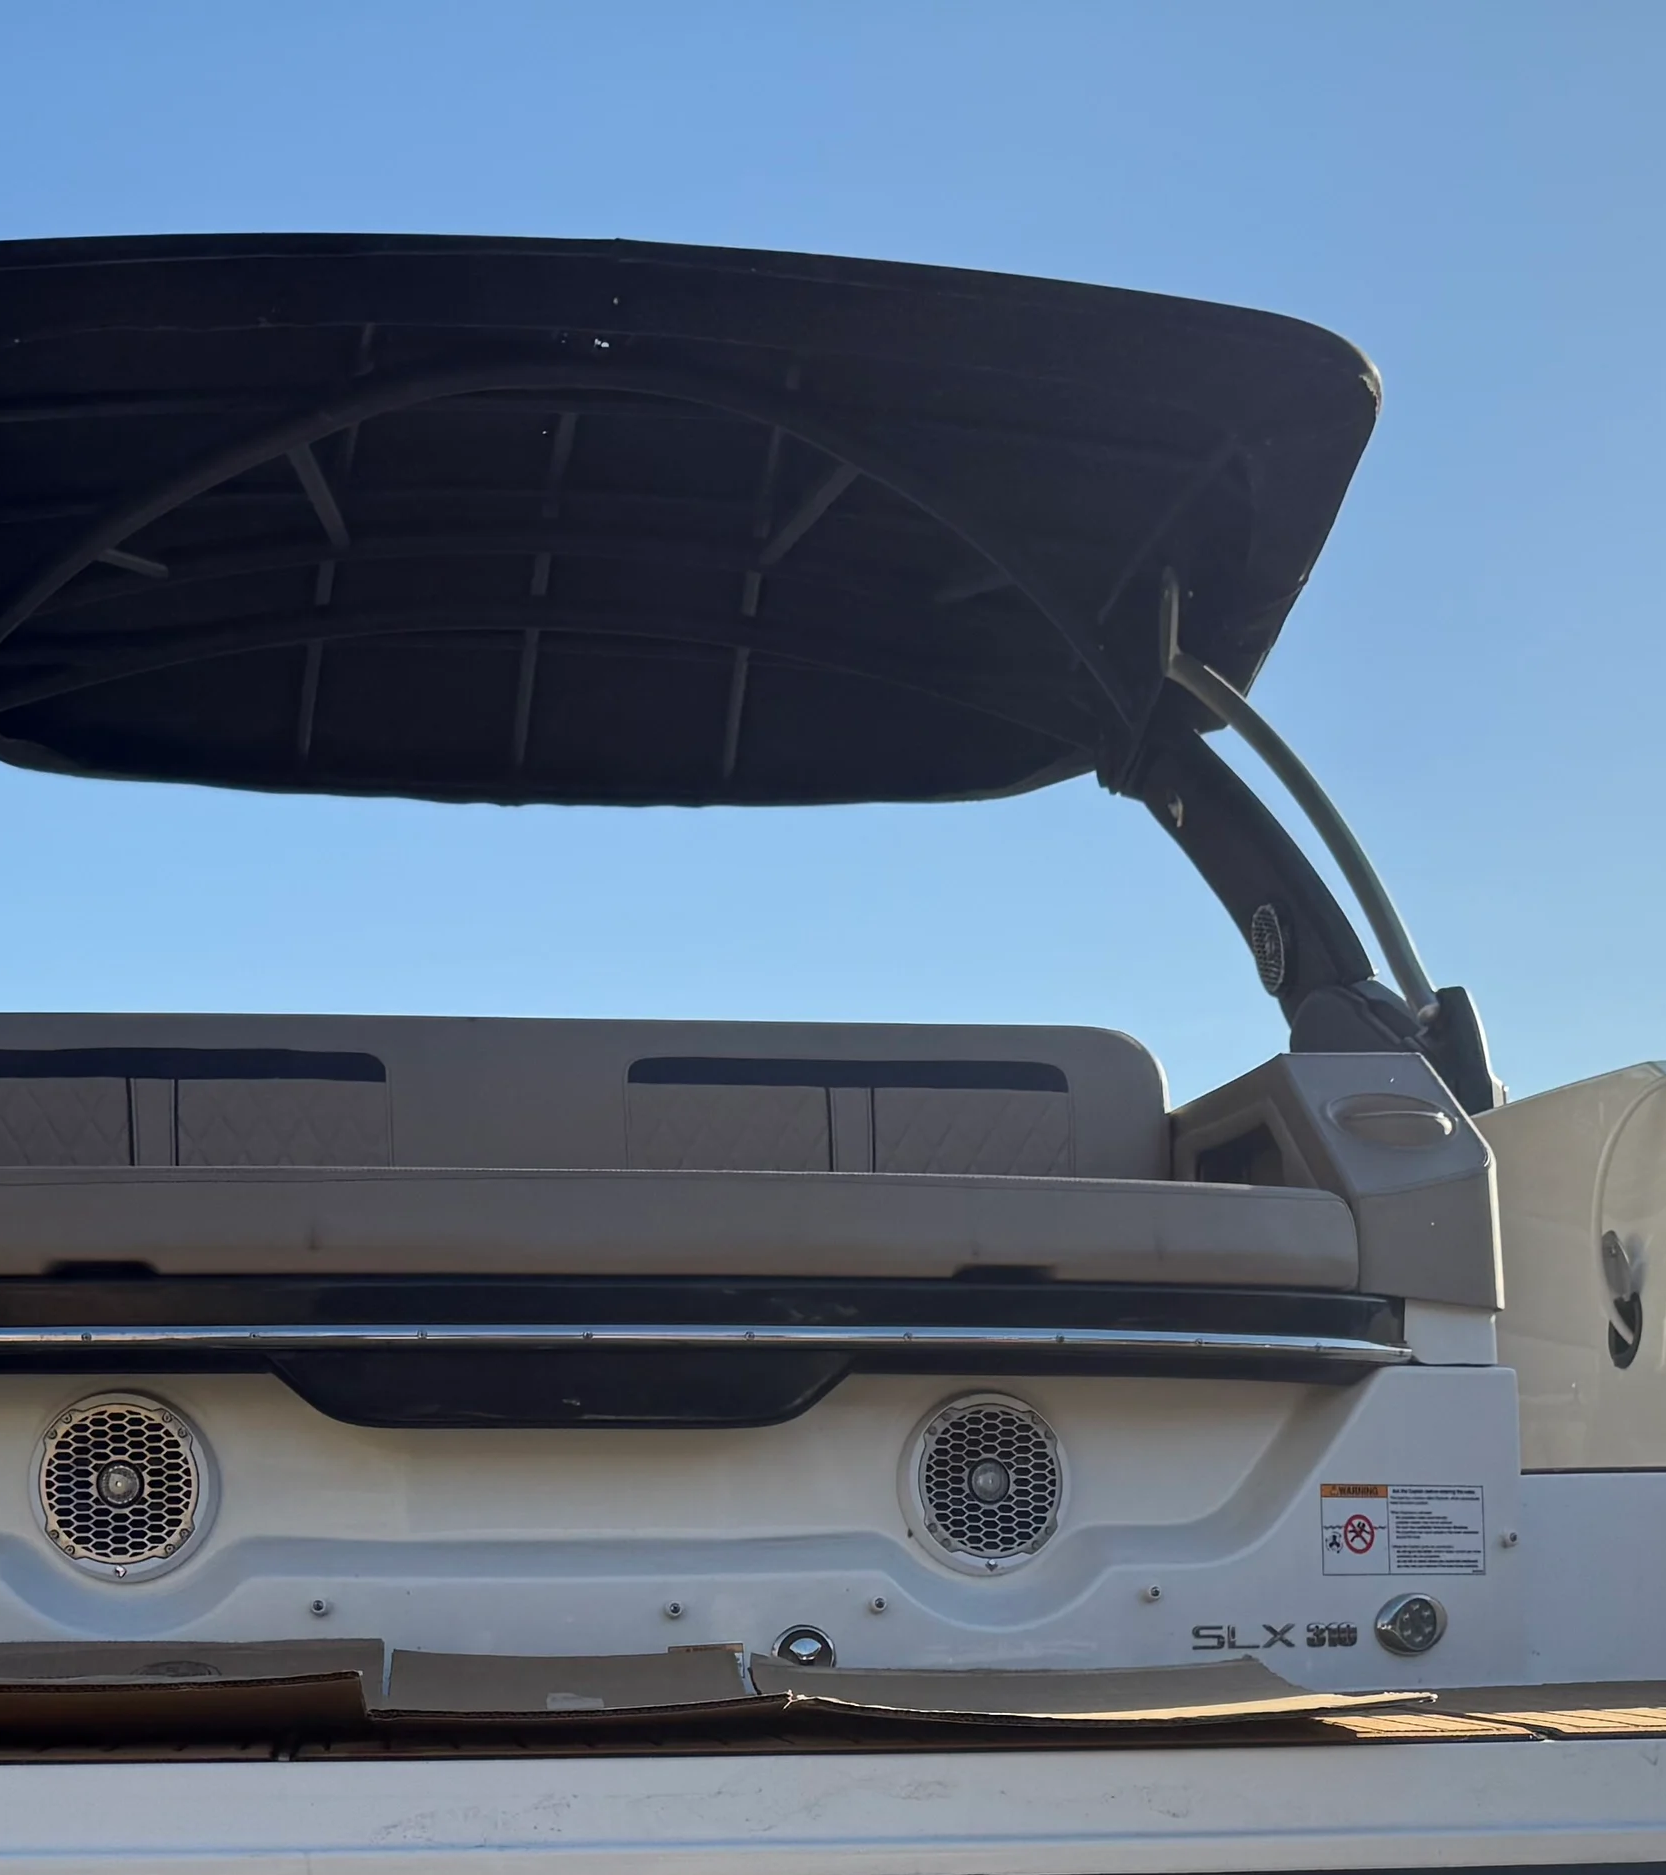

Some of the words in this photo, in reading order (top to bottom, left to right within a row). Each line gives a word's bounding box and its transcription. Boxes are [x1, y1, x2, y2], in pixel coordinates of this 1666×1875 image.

[1339, 1486, 1379, 1496] WARNING
[1192, 1623, 1296, 1650] SLX
[1306, 1621, 1358, 1647] 310
